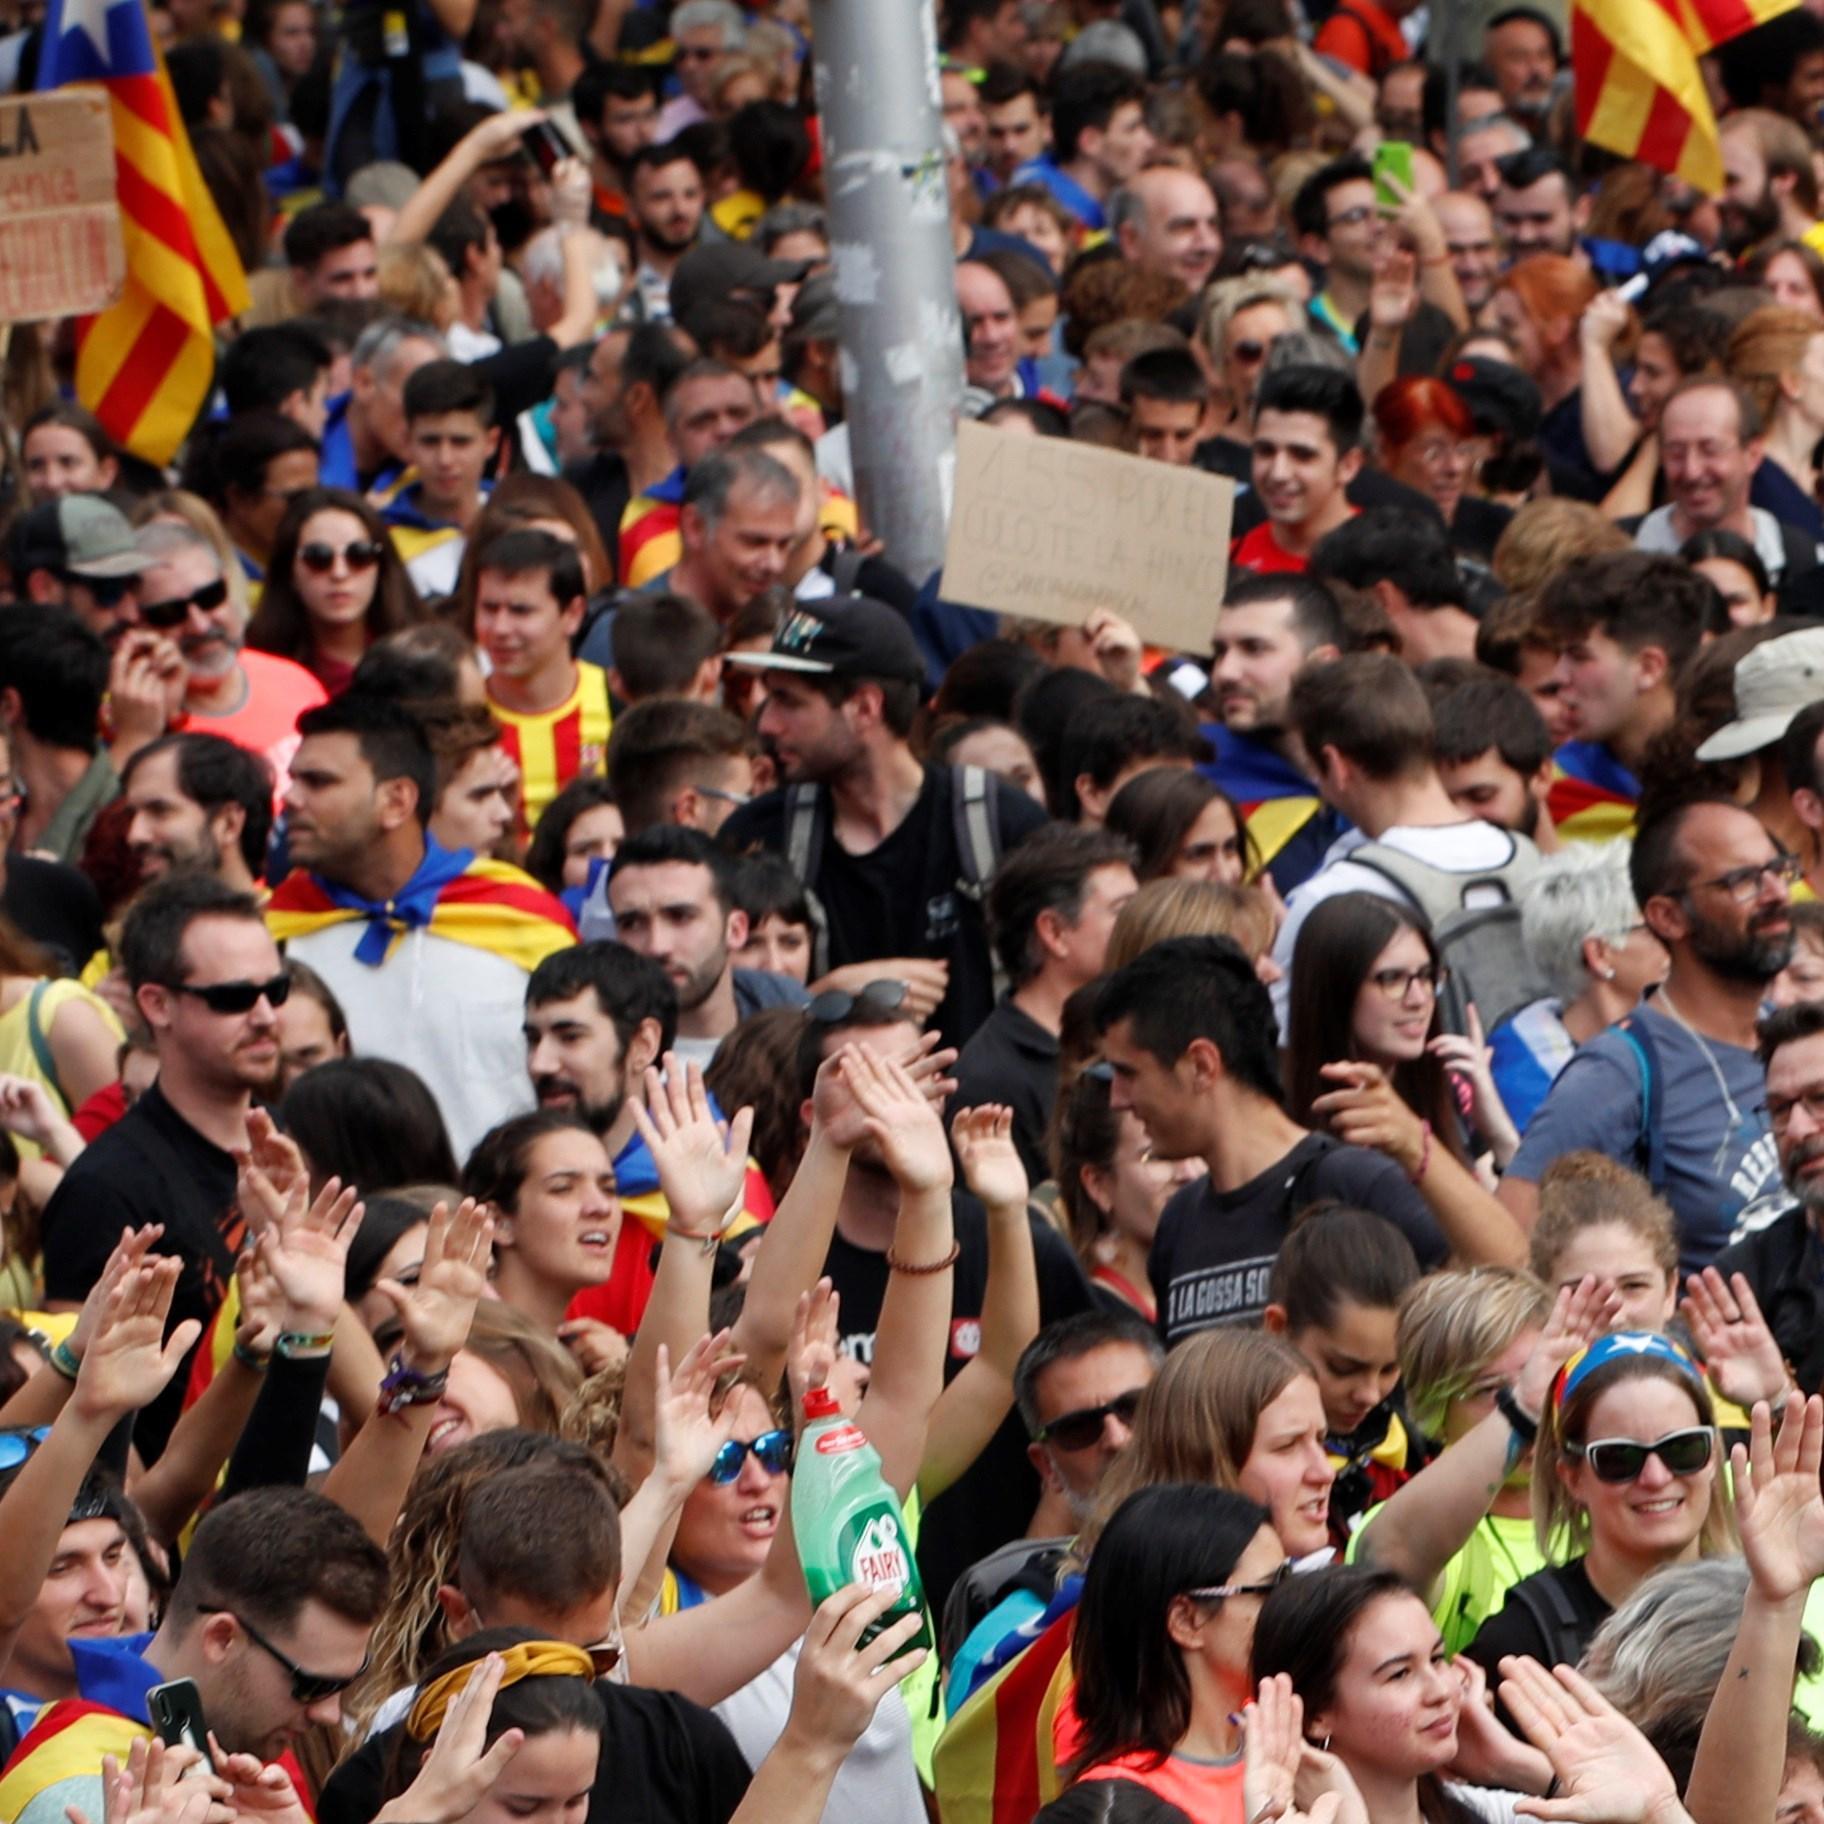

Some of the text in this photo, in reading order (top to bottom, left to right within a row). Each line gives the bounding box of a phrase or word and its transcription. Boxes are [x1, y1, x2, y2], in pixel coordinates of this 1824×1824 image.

[1178, 1283, 1195, 1320] LA
[1196, 1271, 1243, 1316] GOSSA
[860, 1552, 902, 1583] FAIRY
